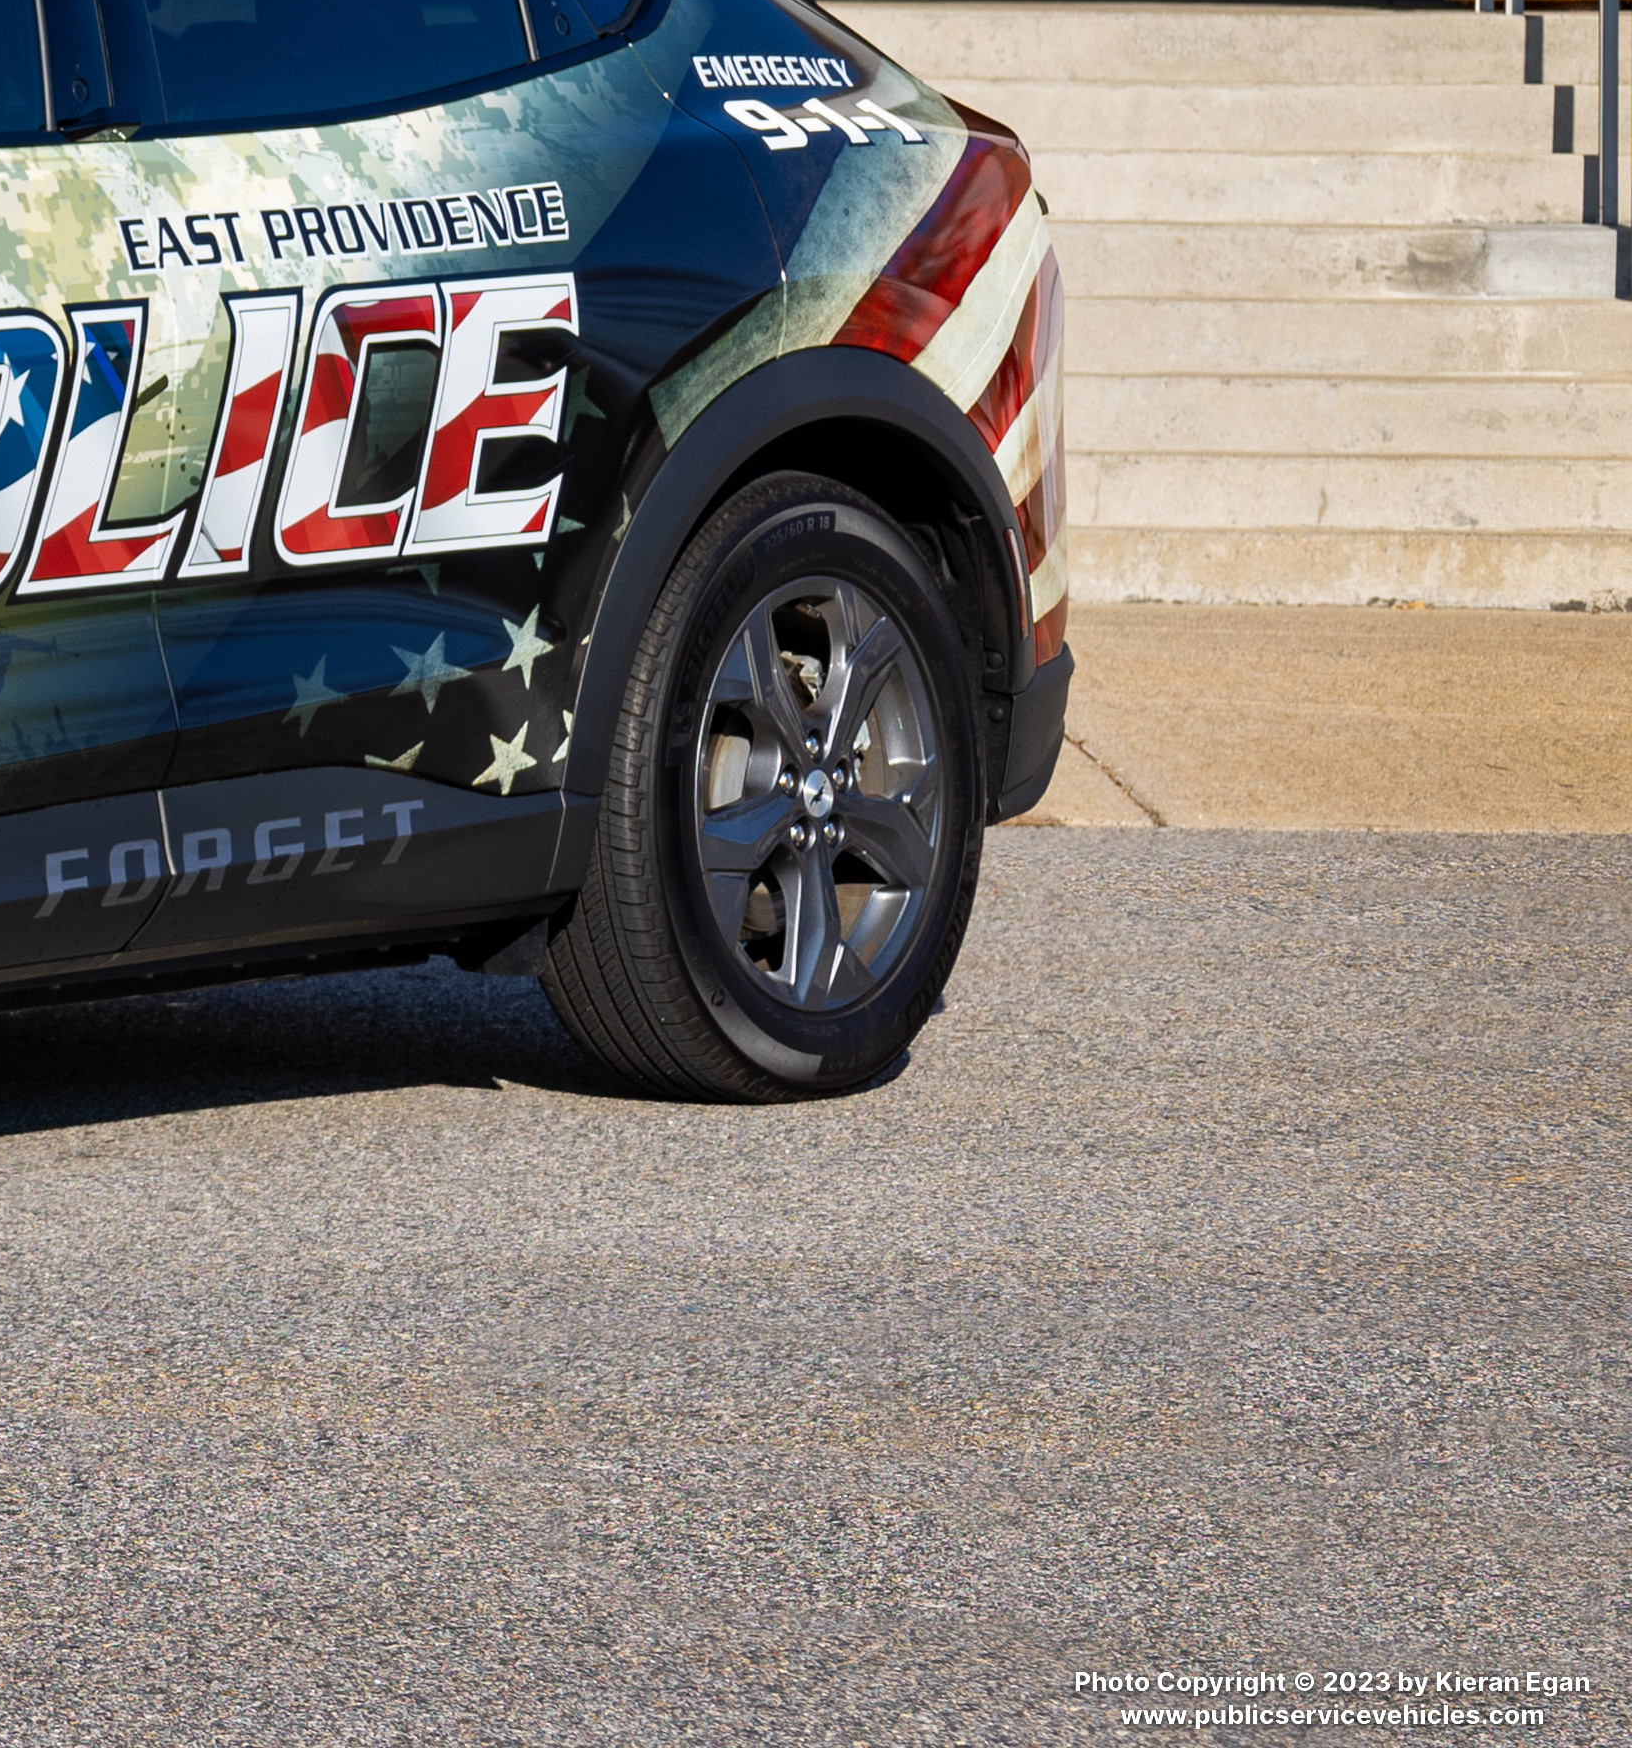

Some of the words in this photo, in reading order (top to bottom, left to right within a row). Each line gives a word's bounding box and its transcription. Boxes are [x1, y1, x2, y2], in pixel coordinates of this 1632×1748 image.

[691, 55, 855, 88] EMERGENCY
[723, 98, 928, 151] 9-1-1
[119, 212, 247, 274] EAST
[260, 182, 570, 260] PROVIDENCE
[764, 520, 804, 553] 225/60
[807, 517, 816, 532] R
[819, 515, 831, 530] 18
[33, 799, 426, 919] FORGET
